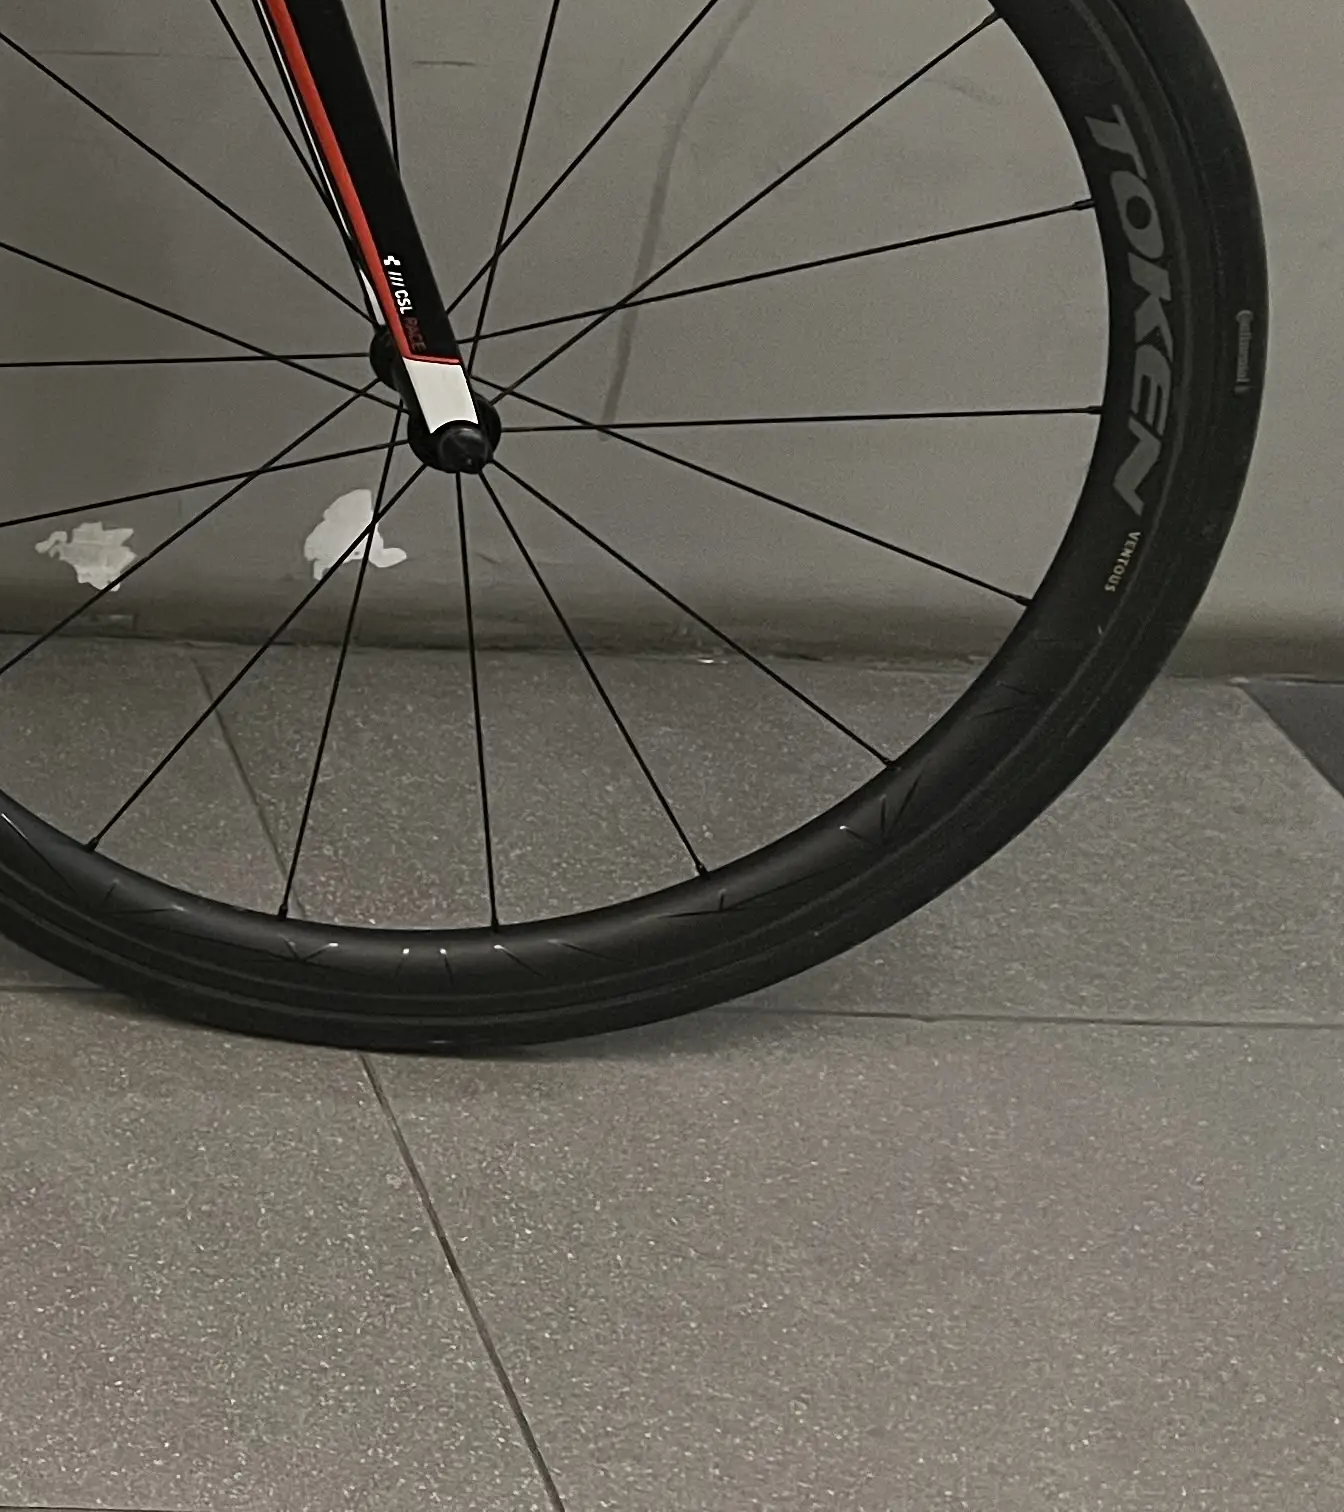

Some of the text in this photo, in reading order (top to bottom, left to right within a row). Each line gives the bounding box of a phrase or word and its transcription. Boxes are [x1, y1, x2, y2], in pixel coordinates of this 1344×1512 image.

[395, 289, 413, 315] CSL
[1084, 104, 1174, 516] TOKEN
[1104, 531, 1142, 592] VENTOUS
